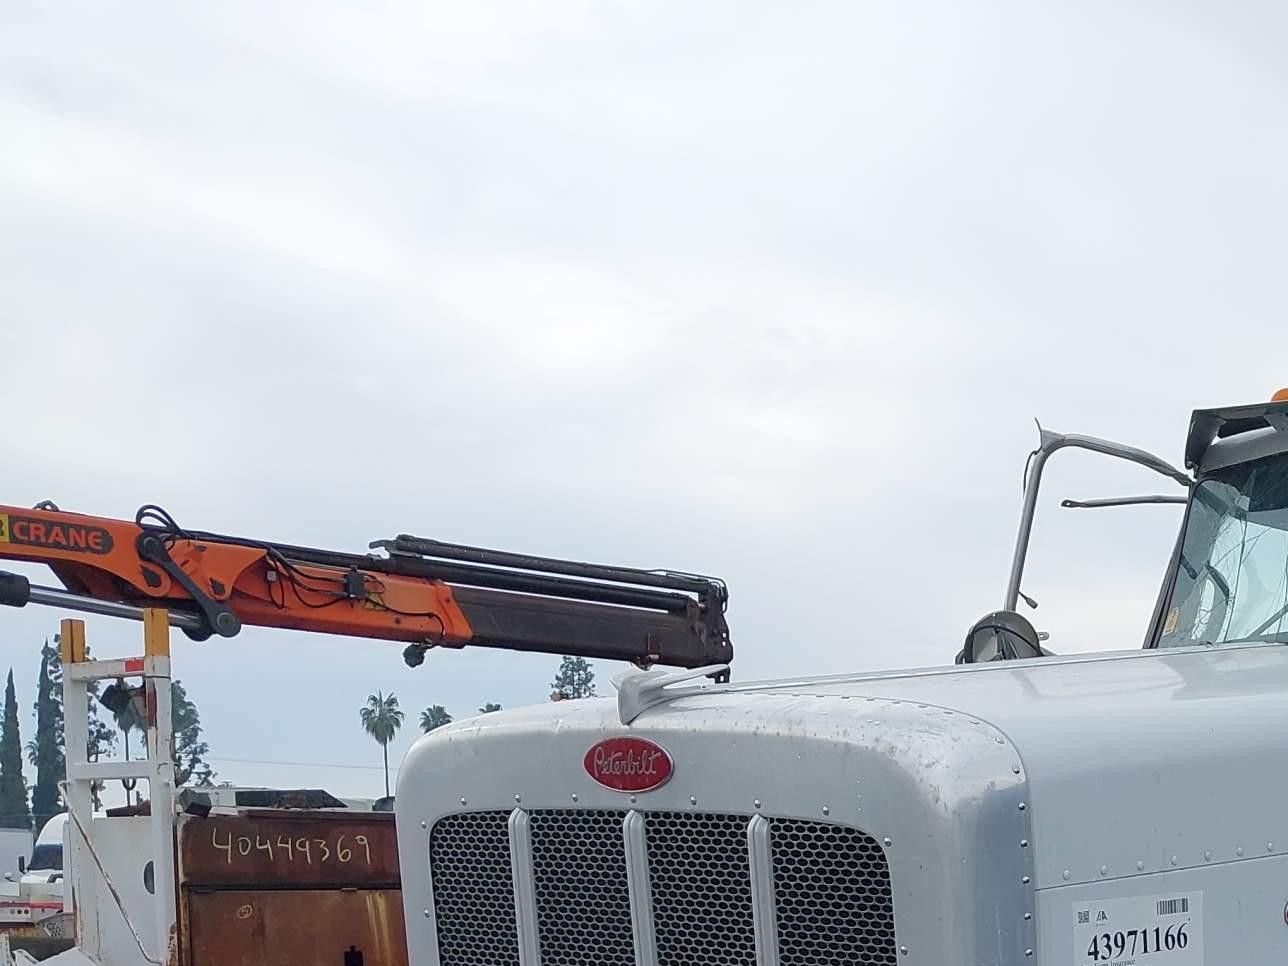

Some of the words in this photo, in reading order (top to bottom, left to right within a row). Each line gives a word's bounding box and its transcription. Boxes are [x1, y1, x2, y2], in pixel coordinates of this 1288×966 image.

[12, 521, 103, 550] CRANE
[593, 746, 661, 778] Peterbilt
[212, 828, 371, 865] 40449369
[1087, 922, 1188, 961] 43971166
